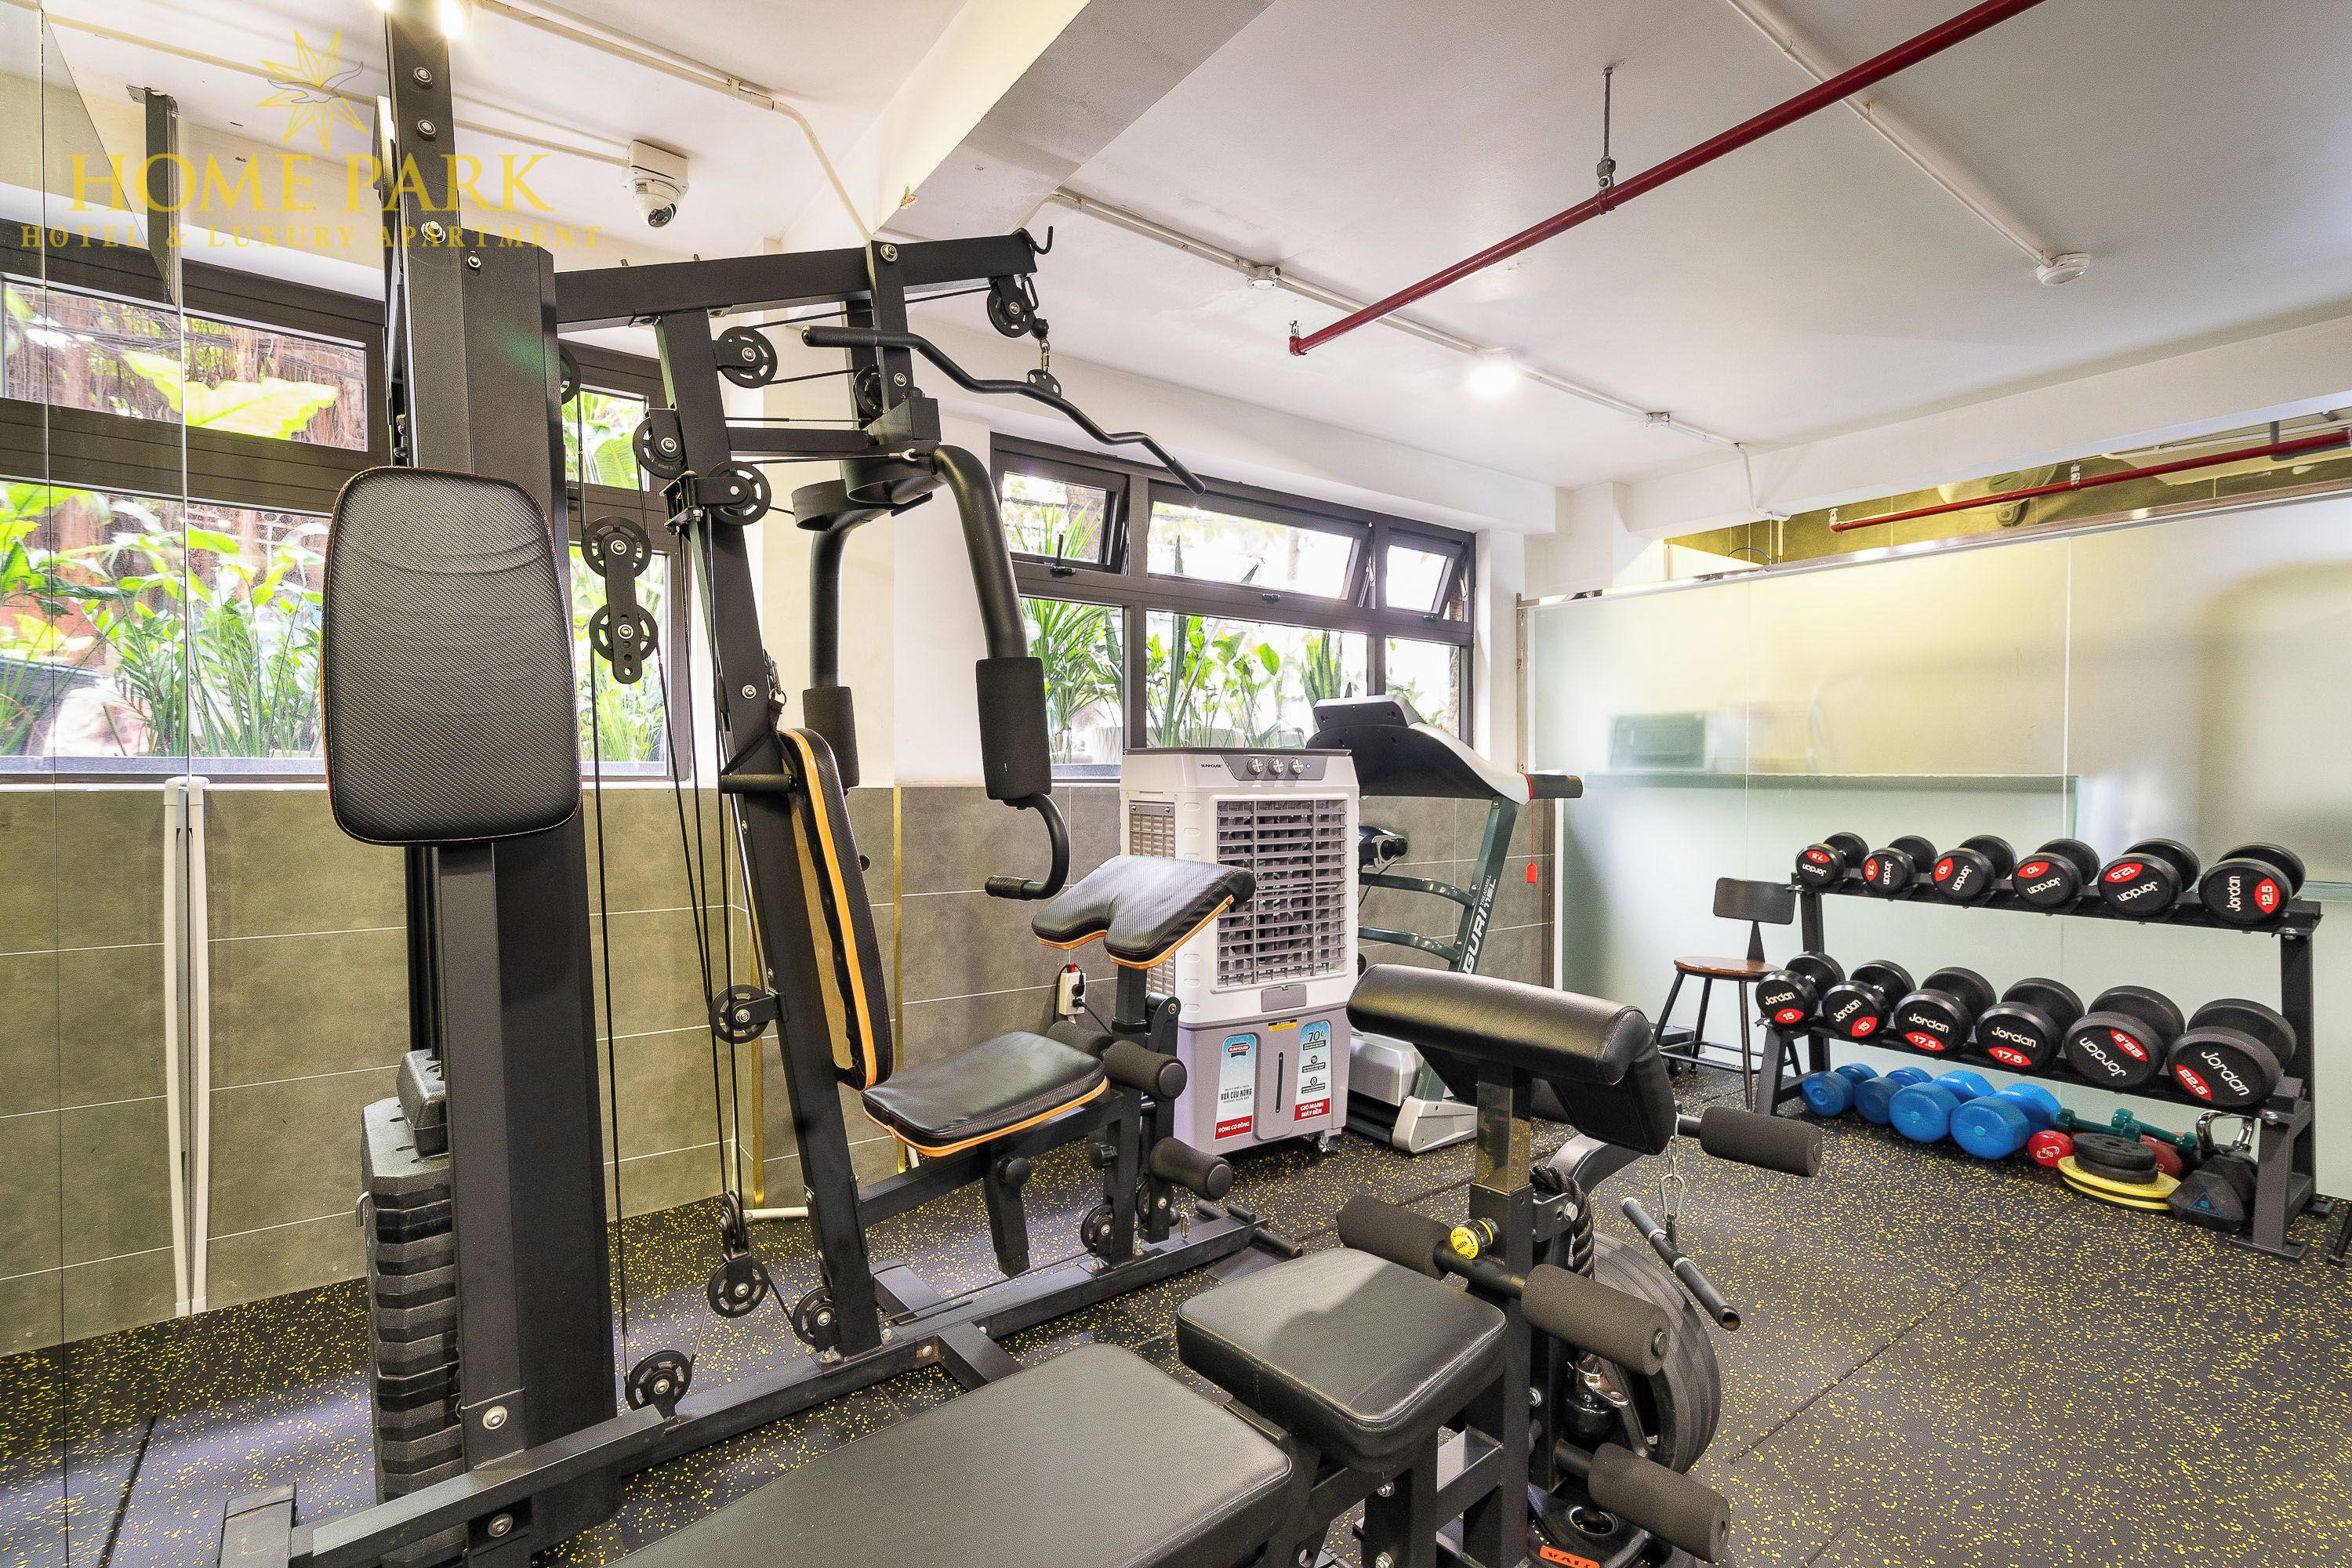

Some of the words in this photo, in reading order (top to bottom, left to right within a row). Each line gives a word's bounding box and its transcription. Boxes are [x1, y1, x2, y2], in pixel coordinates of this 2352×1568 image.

[1802, 863, 1827, 877] Jordan
[1882, 860, 1893, 885] Jordan
[1951, 865, 1973, 891] Jordan
[2026, 865, 2040, 874] 10
[2111, 866, 2136, 880] 12.5
[2027, 877, 2061, 895] Jordan
[2117, 880, 2158, 902] Jordan
[2226, 876, 2241, 912] Jordan
[2261, 885, 2273, 906] 12.5
[1765, 991, 1795, 1006] Jordan
[1783, 1011, 1795, 1021] 15
[1833, 999, 1862, 1022] Jordan
[1857, 1021, 1871, 1032] 15
[1908, 1013, 1950, 1033] Jordan
[1913, 1034, 1936, 1049] 17.5
[1991, 1026, 2037, 1048] Jordan
[2113, 1033, 2143, 1058] 22.5
[1997, 1050, 2023, 1065] 17.5
[2079, 1036, 2127, 1077] Jordan
[2178, 1069, 2209, 1095] 22.5
[2200, 1051, 2250, 1096] Jordan
